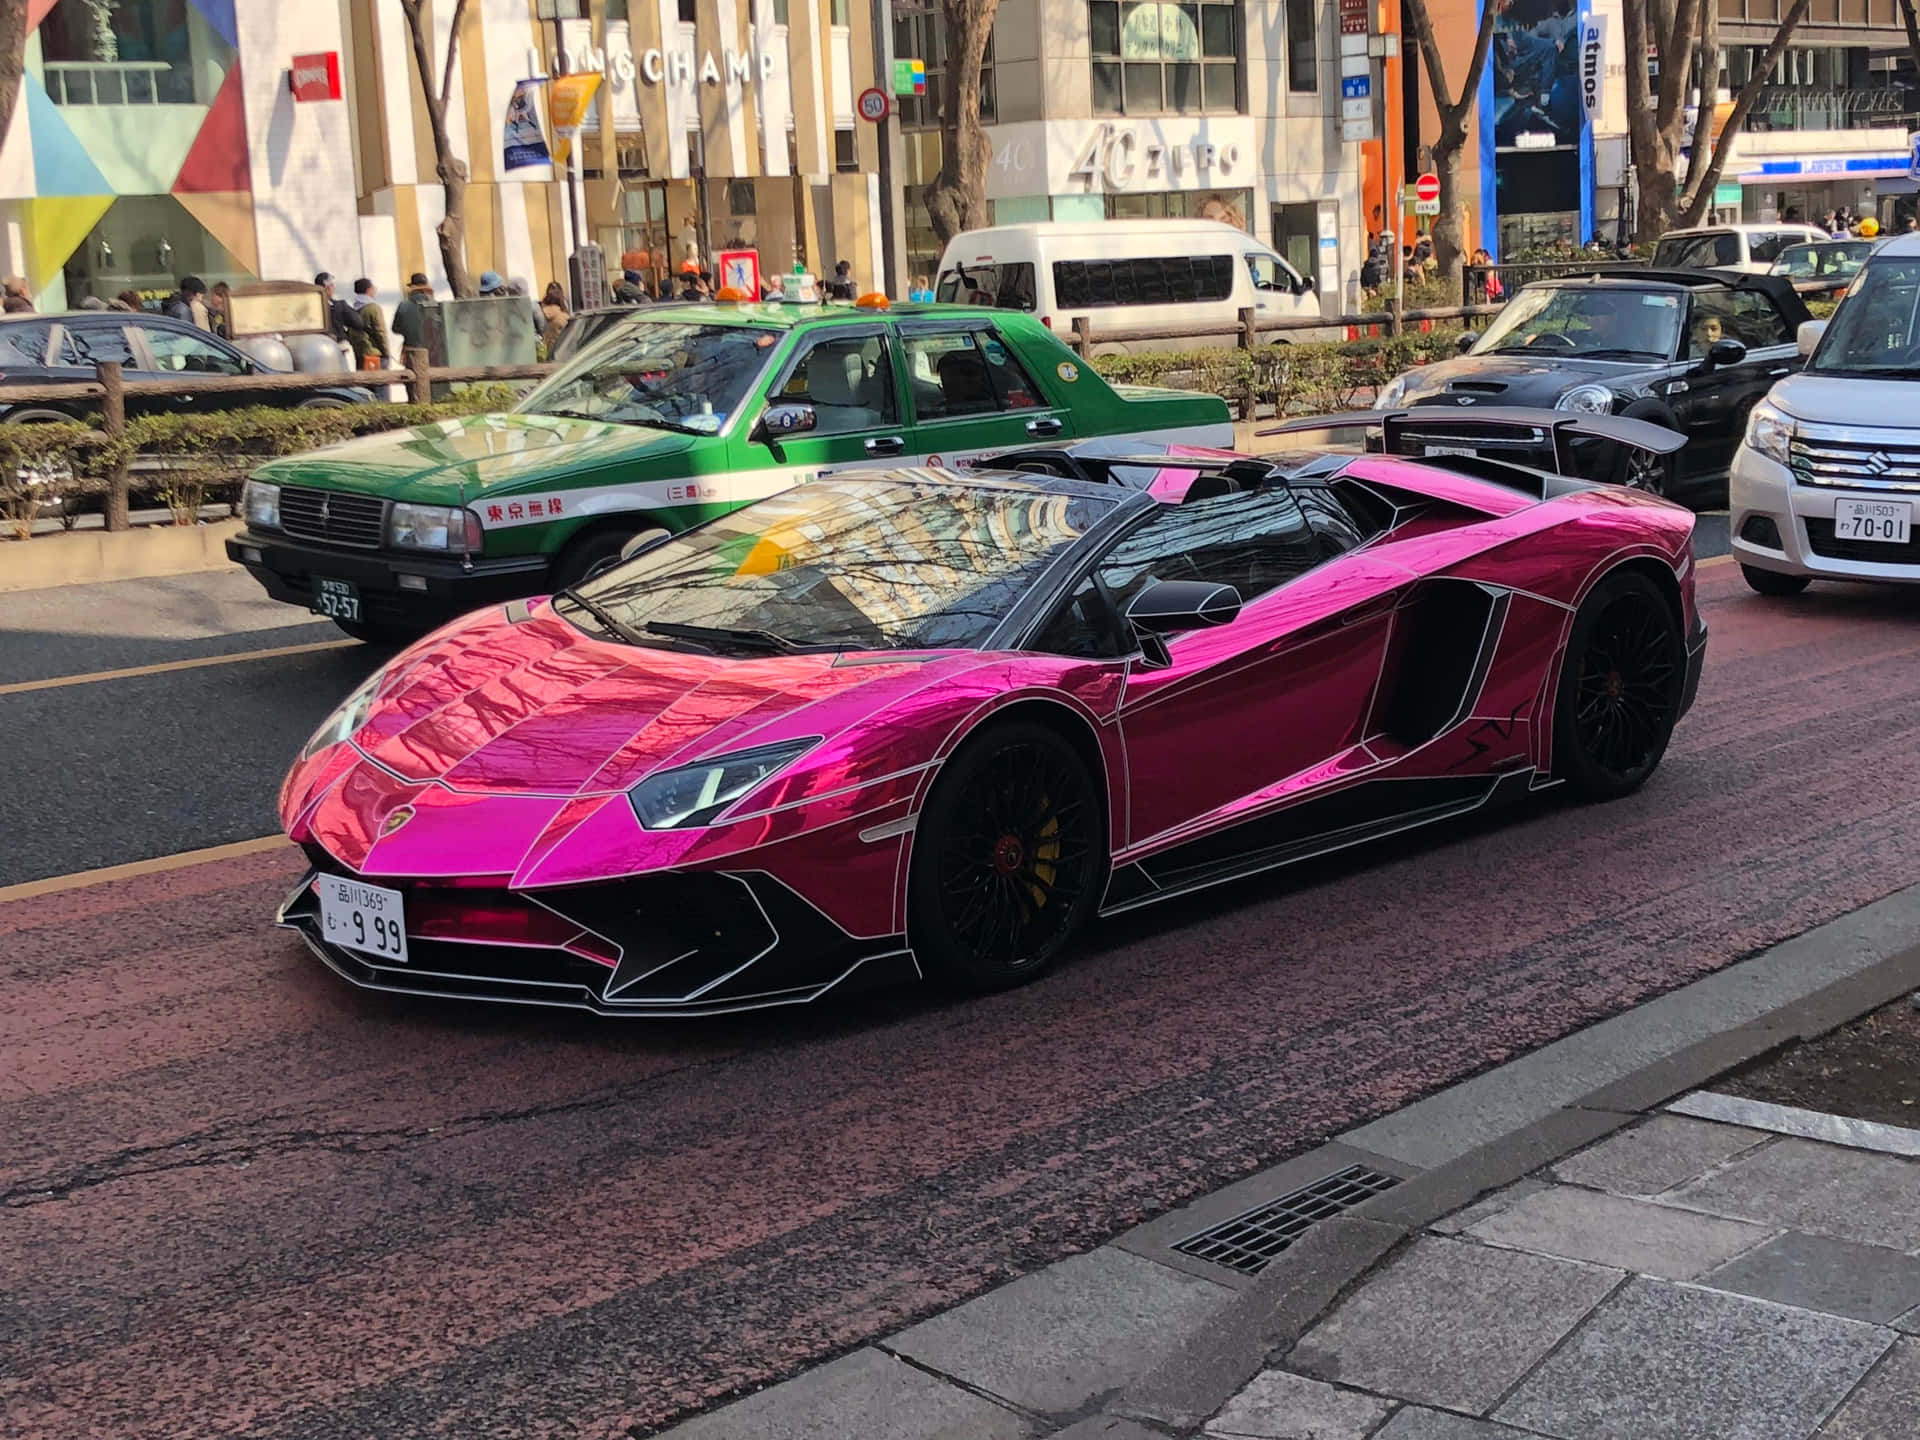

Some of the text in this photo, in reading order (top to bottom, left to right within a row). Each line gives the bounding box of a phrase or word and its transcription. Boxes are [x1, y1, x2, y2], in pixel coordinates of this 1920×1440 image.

[529, 47, 776, 83] LONGCHAMP
[1584, 27, 1601, 109] atmos
[864, 99, 883, 114] 50
[1147, 144, 1240, 178] ZERO
[487, 497, 564, 523] 東京無線
[1854, 504, 1895, 517] 品川503
[1852, 516, 1903, 540] 70-01
[321, 592, 359, 620] 52-57
[338, 883, 384, 912] 品川369
